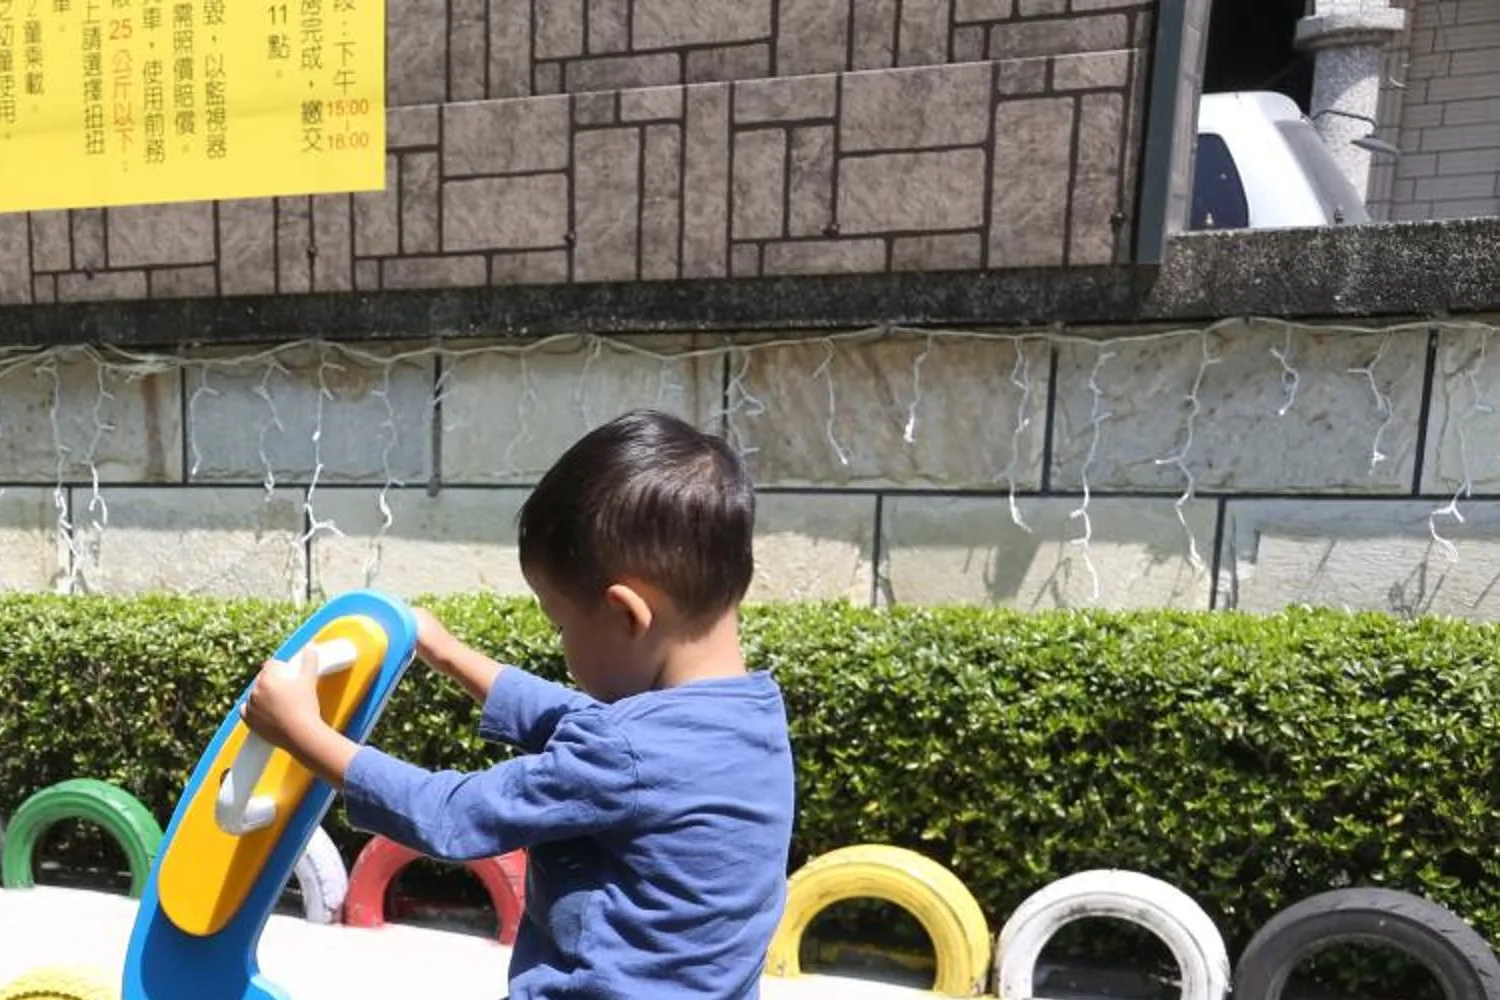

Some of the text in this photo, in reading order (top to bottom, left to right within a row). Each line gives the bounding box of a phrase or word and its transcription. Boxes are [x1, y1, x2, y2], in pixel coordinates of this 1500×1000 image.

[140, 0, 165, 164] 車，使用前務
